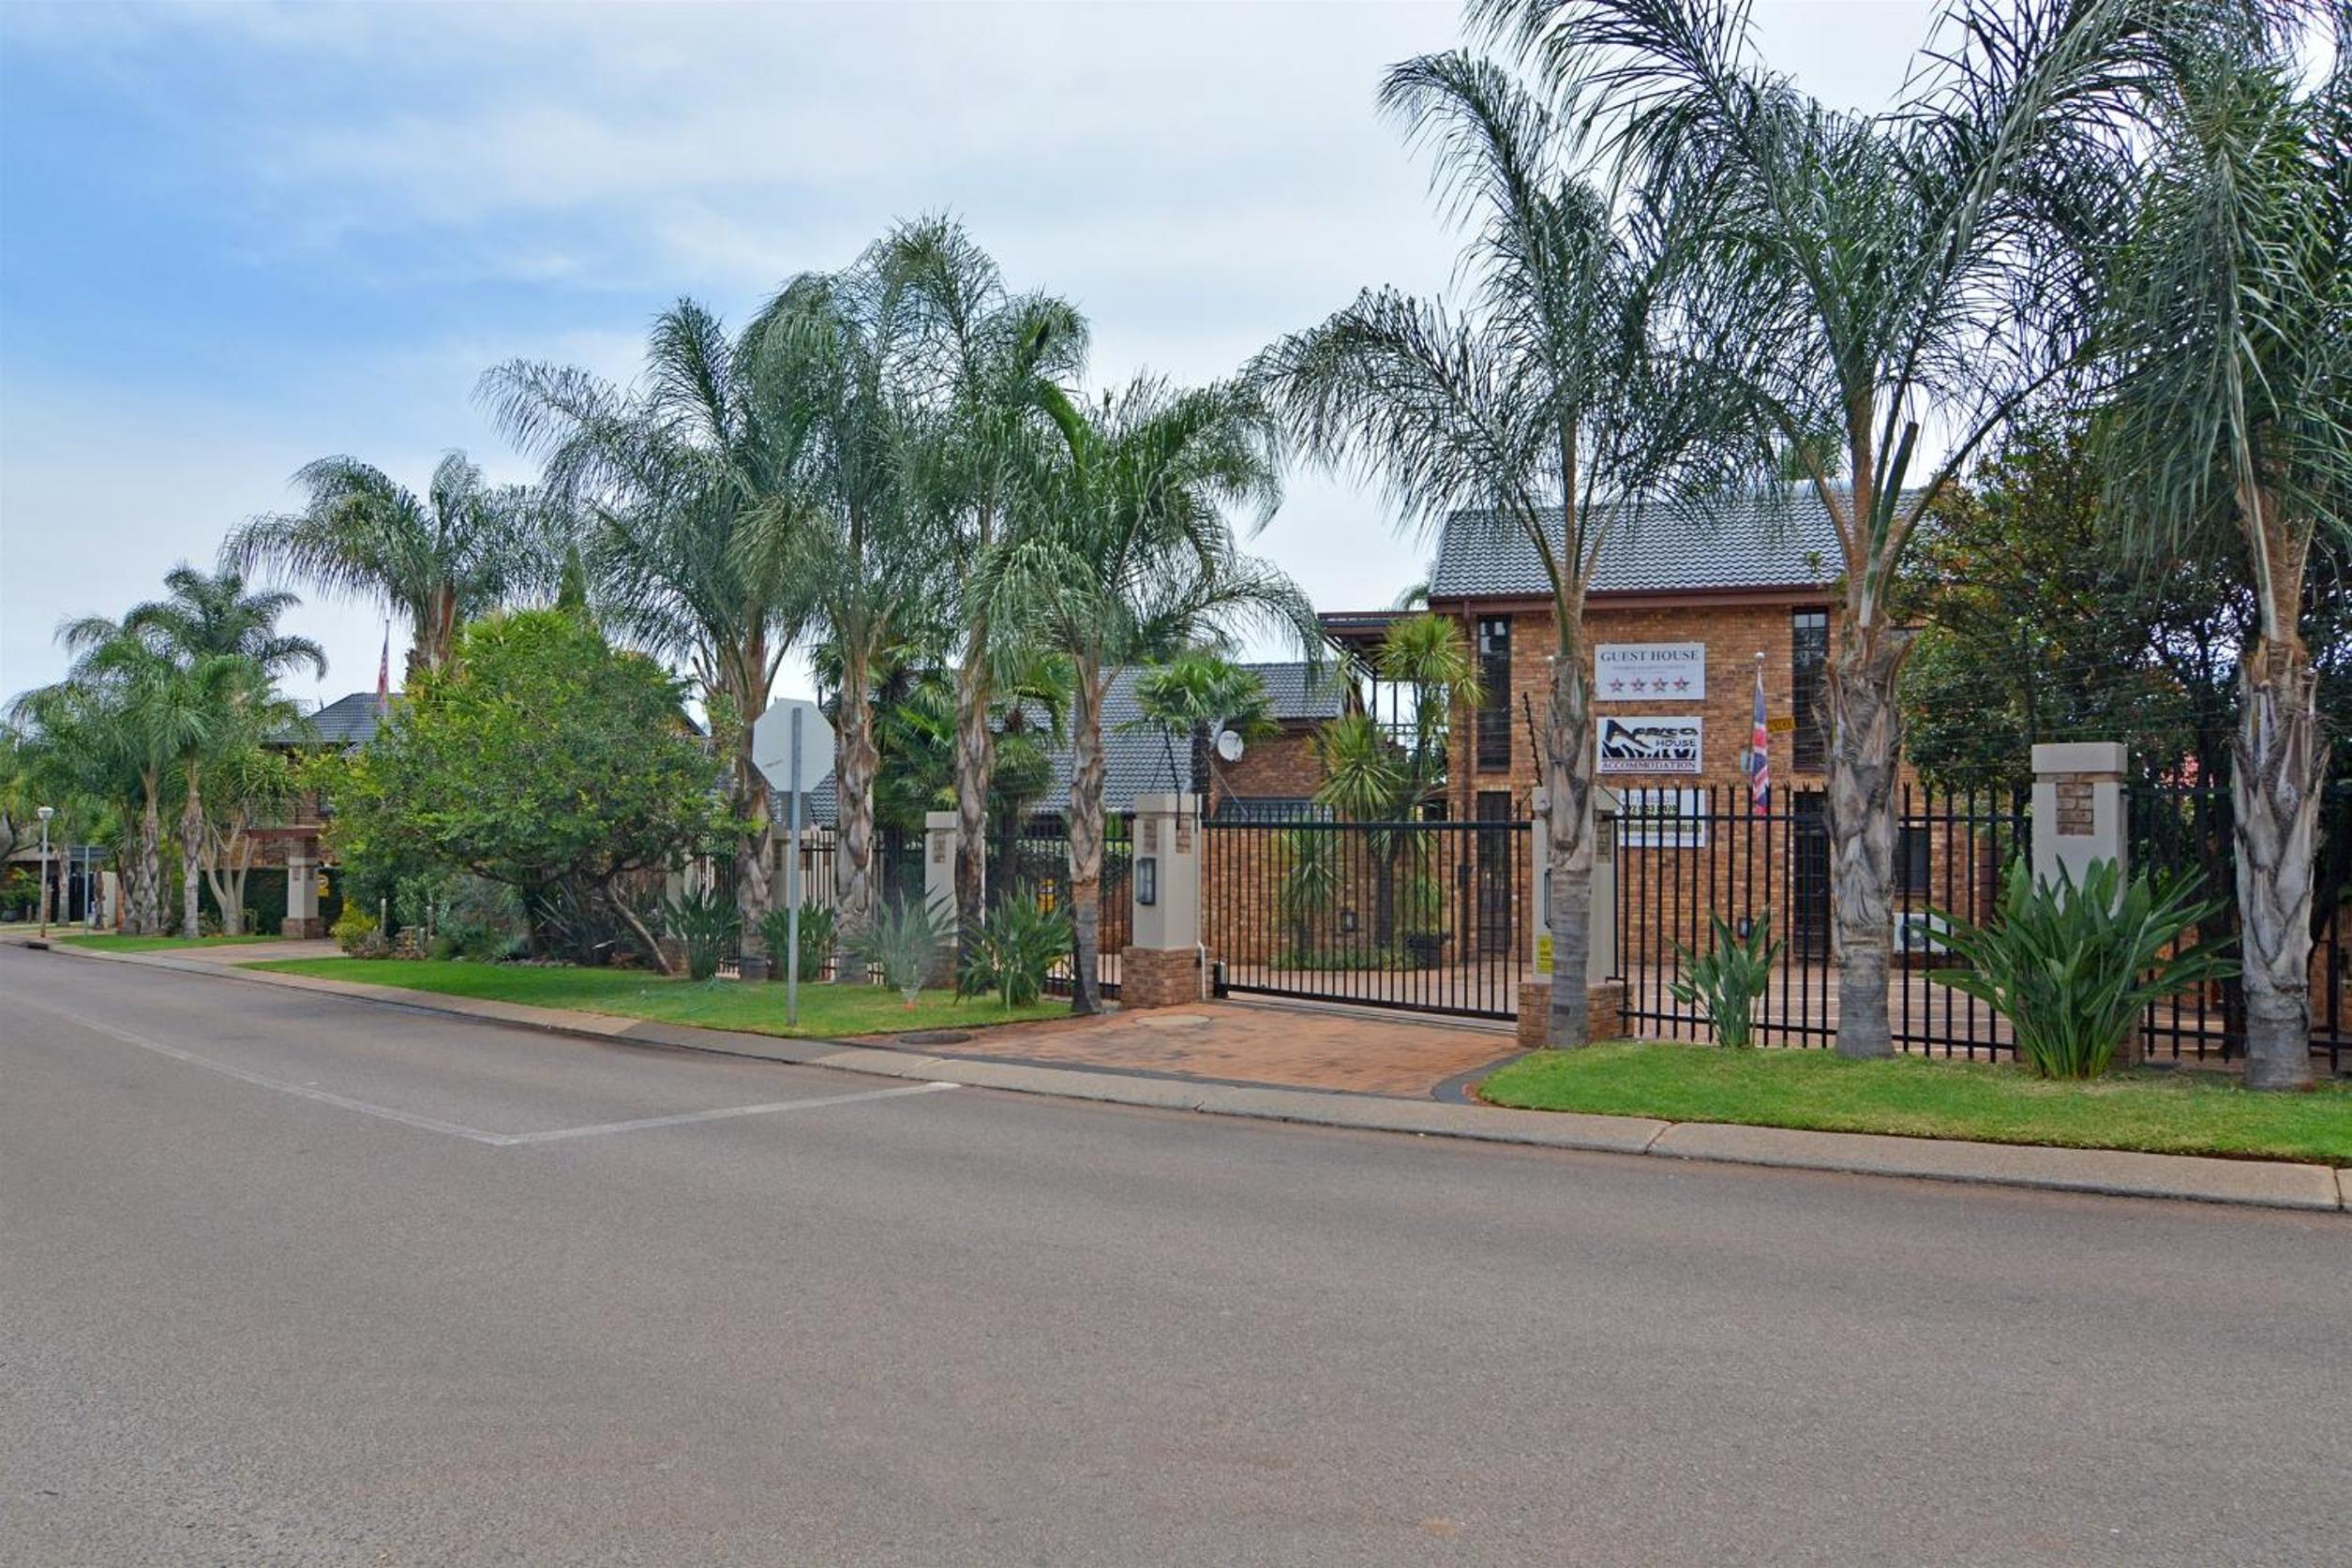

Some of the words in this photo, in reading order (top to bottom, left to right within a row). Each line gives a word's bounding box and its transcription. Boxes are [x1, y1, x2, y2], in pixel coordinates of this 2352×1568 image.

[1600, 650, 1646, 662] GUEST
[1651, 650, 1699, 661] HOUSE
[1655, 739, 1697, 748] HOUSE
[1601, 761, 1696, 769] ACCOMMODATION
